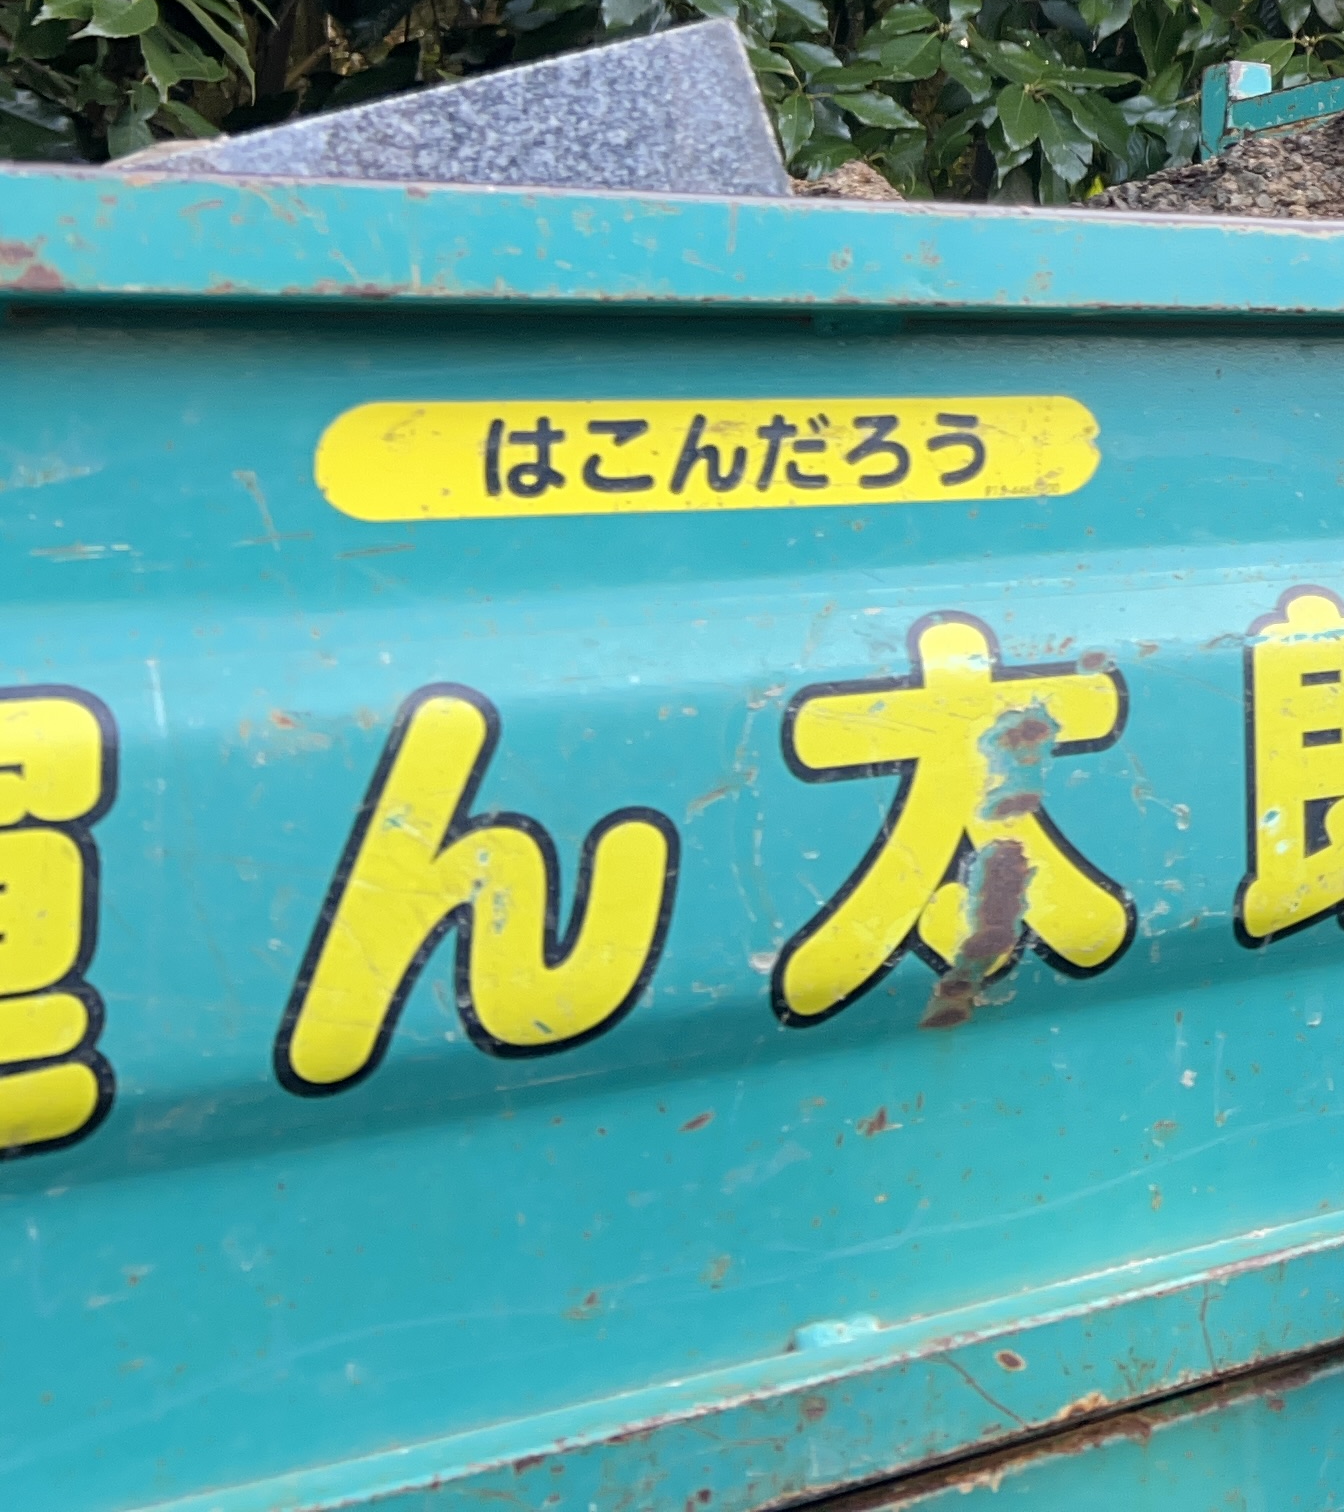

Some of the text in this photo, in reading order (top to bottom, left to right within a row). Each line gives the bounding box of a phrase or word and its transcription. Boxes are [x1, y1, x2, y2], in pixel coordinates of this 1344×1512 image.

[484, 412, 988, 499] はこんだろう
